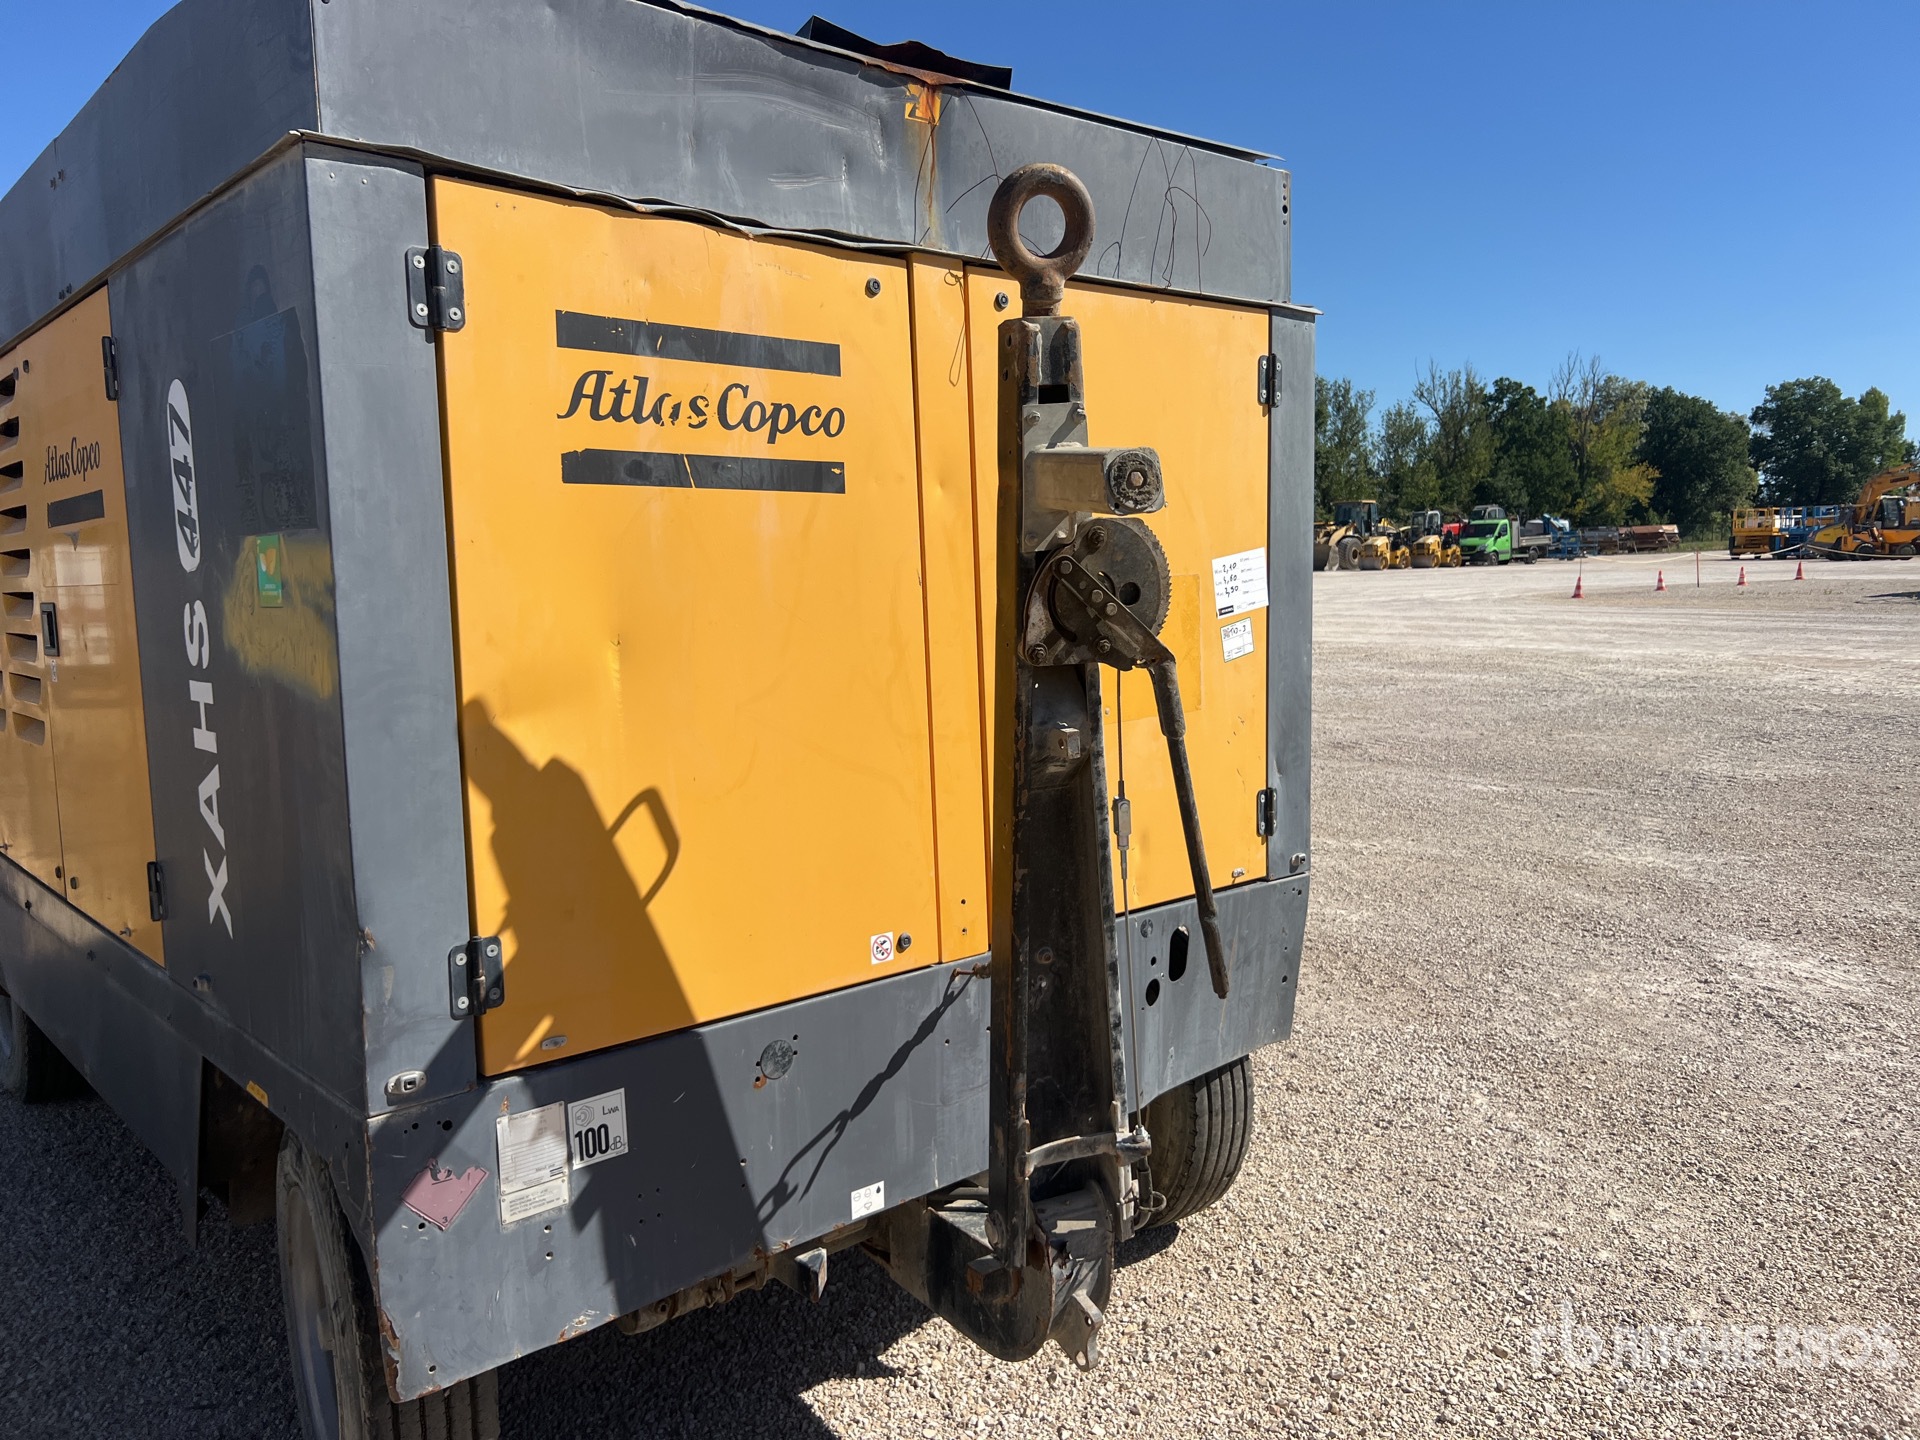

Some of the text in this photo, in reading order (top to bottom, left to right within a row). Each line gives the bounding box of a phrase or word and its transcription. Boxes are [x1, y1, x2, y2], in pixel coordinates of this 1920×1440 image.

[557, 370, 846, 445] Atlas Copco
[44, 436, 100, 485] Atlas Copco
[168, 402, 234, 940] XAHS 447
[574, 1123, 610, 1162] 100
